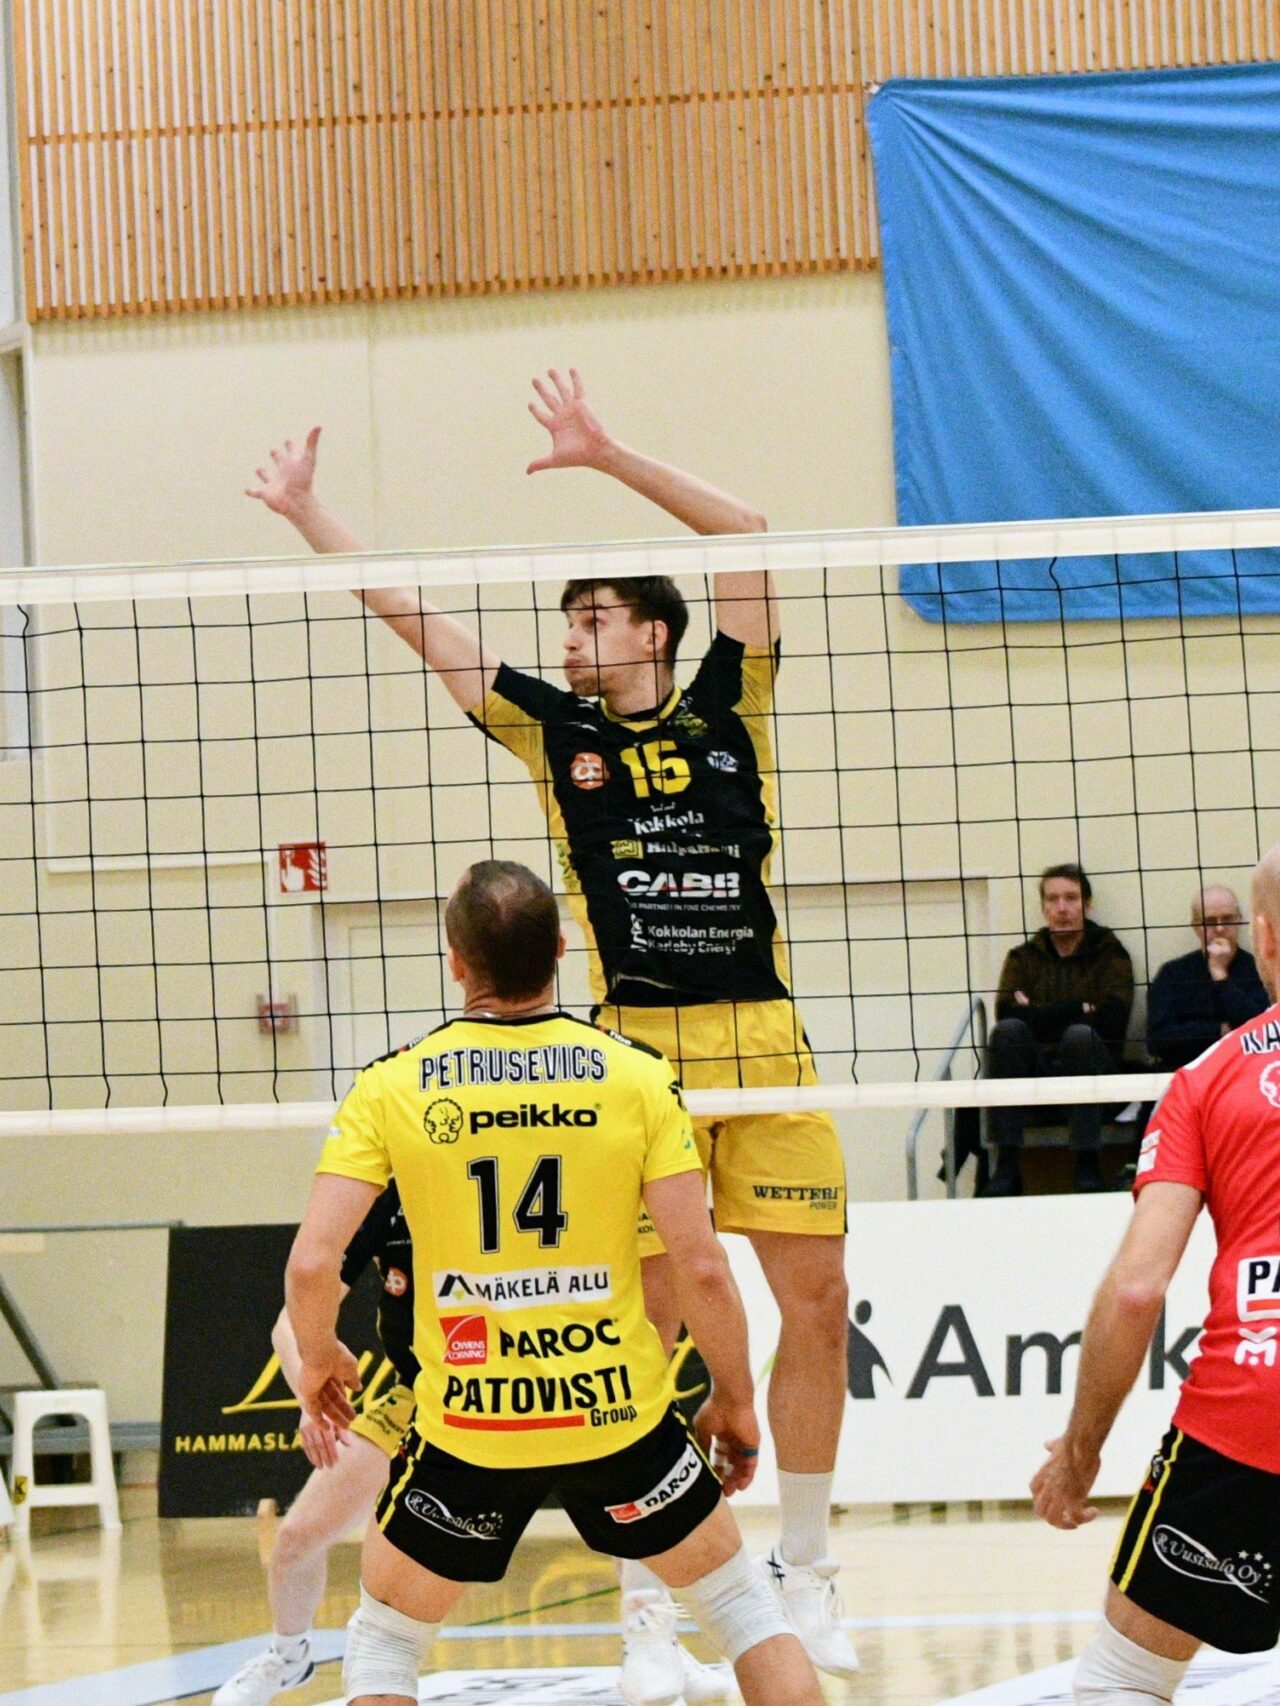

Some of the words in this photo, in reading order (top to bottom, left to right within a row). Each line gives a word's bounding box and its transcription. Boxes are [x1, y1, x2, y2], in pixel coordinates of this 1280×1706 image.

[620, 740, 691, 798] 15
[419, 1045, 607, 1092] PETRUSEVICS
[470, 1104, 598, 1134] peikko
[467, 1155, 568, 1254] 14
[475, 1271, 560, 1301] MÄKELÄ
[568, 1271, 609, 1293] ALU
[499, 1318, 621, 1359] PAROC
[443, 1364, 632, 1414] PATOVISTI
[590, 1404, 637, 1427] Group
[175, 1428, 304, 1453] HAMMASLÄ
[1238, 1564, 1261, 1586] Oy
